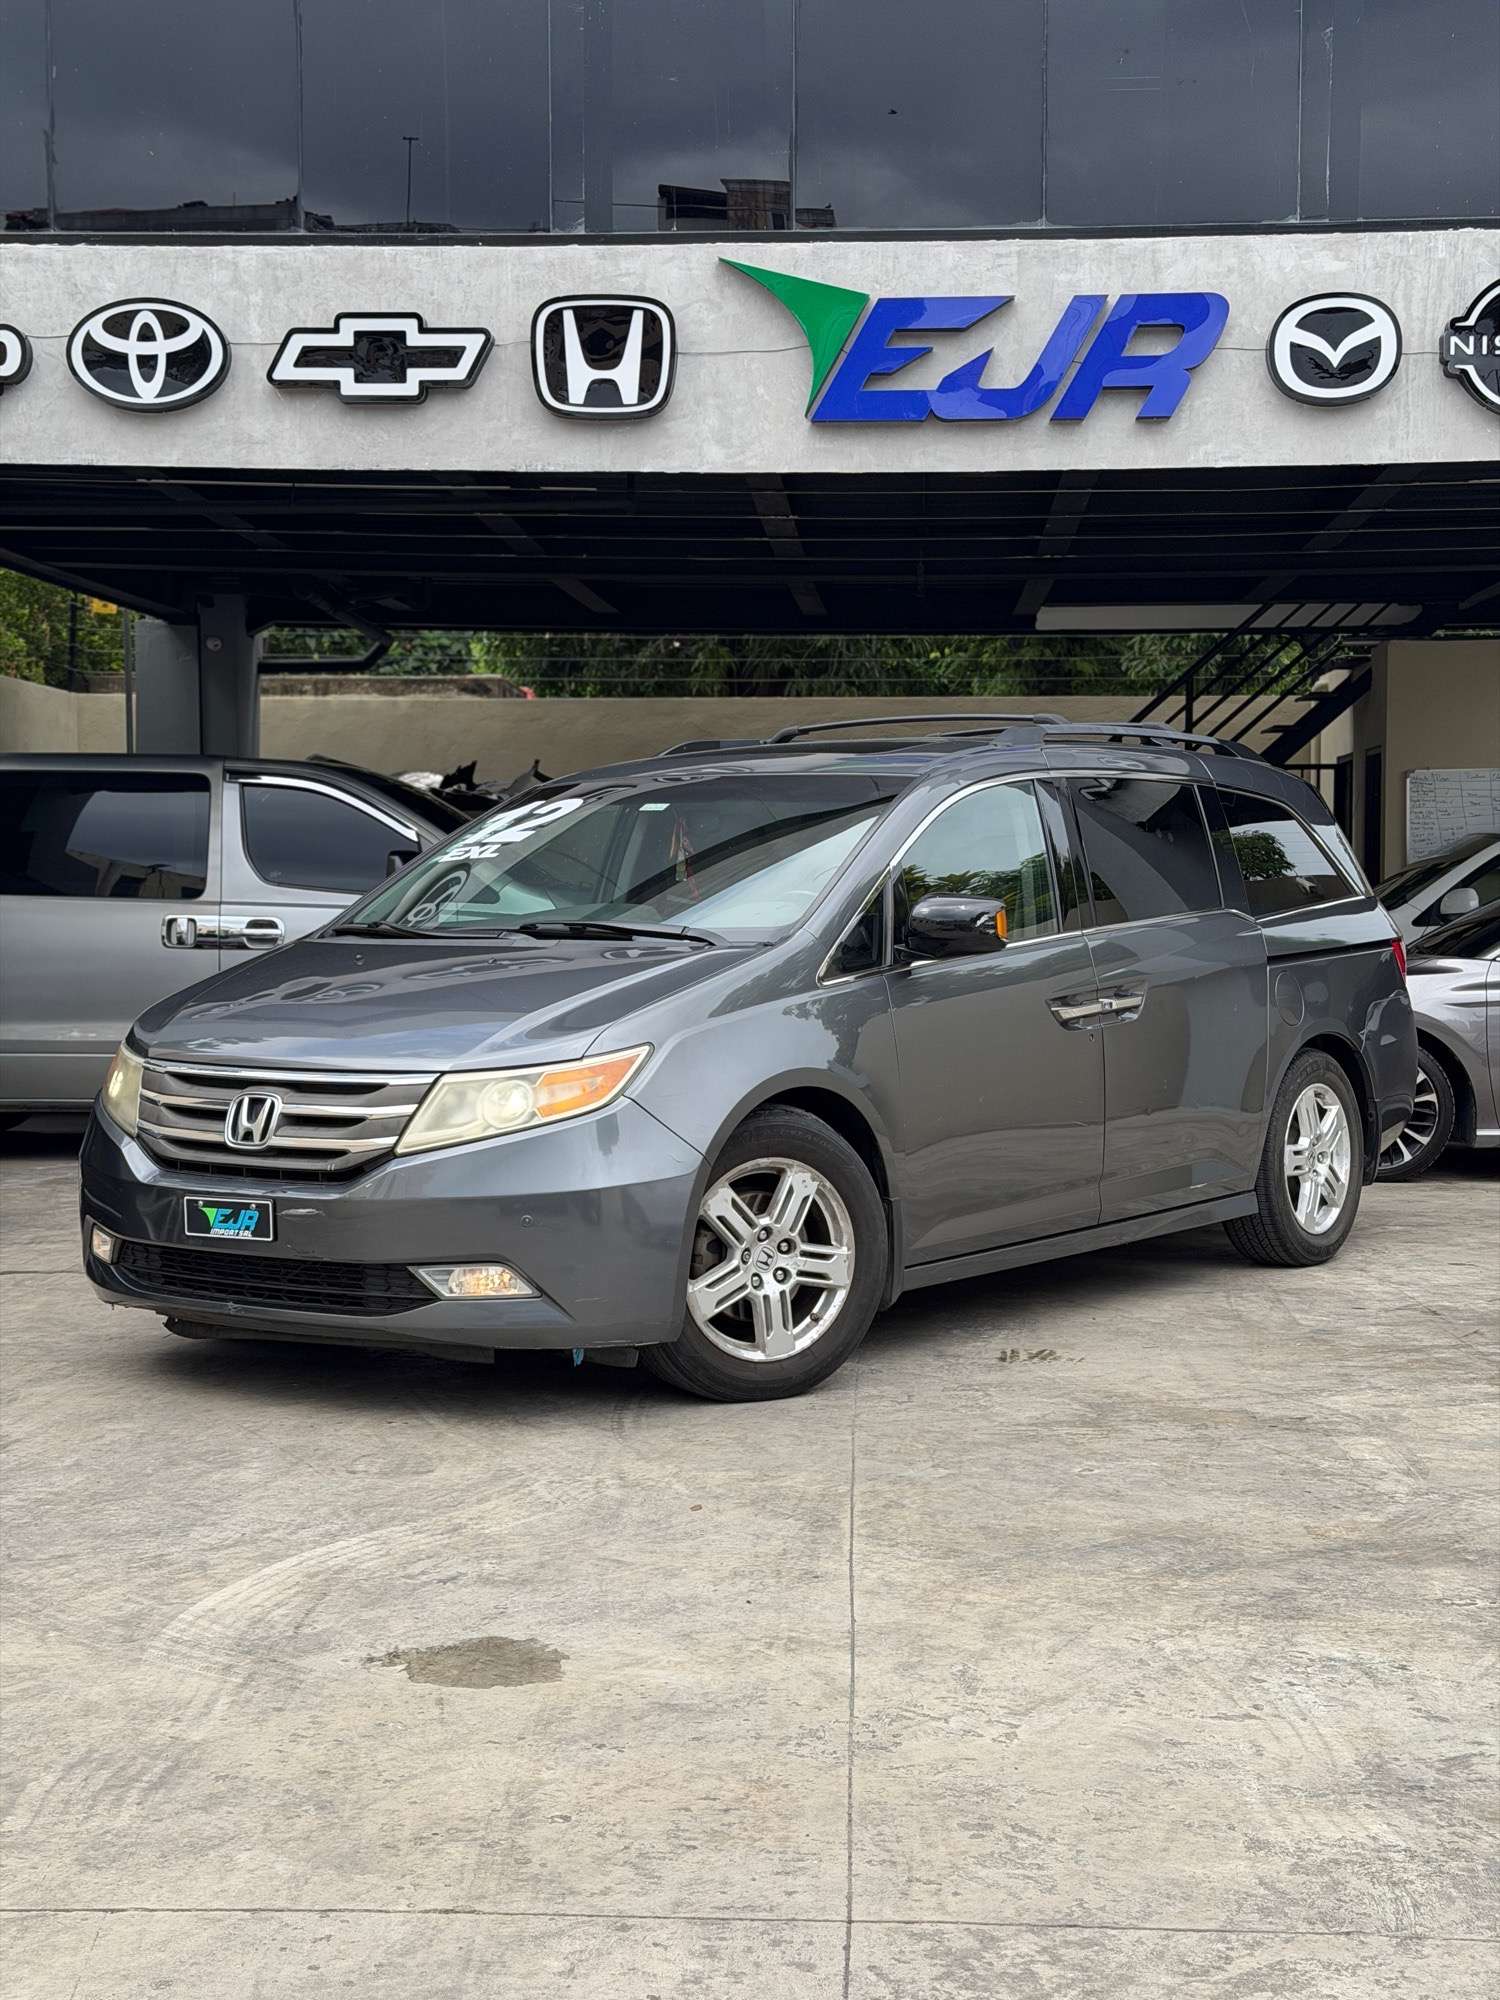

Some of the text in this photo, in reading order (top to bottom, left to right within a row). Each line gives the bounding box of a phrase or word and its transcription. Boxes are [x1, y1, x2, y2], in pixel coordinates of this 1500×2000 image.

[811, 292, 1230, 422] EJR
[212, 1208, 259, 1231] EJR
[210, 1228, 239, 1237] IMPORT
